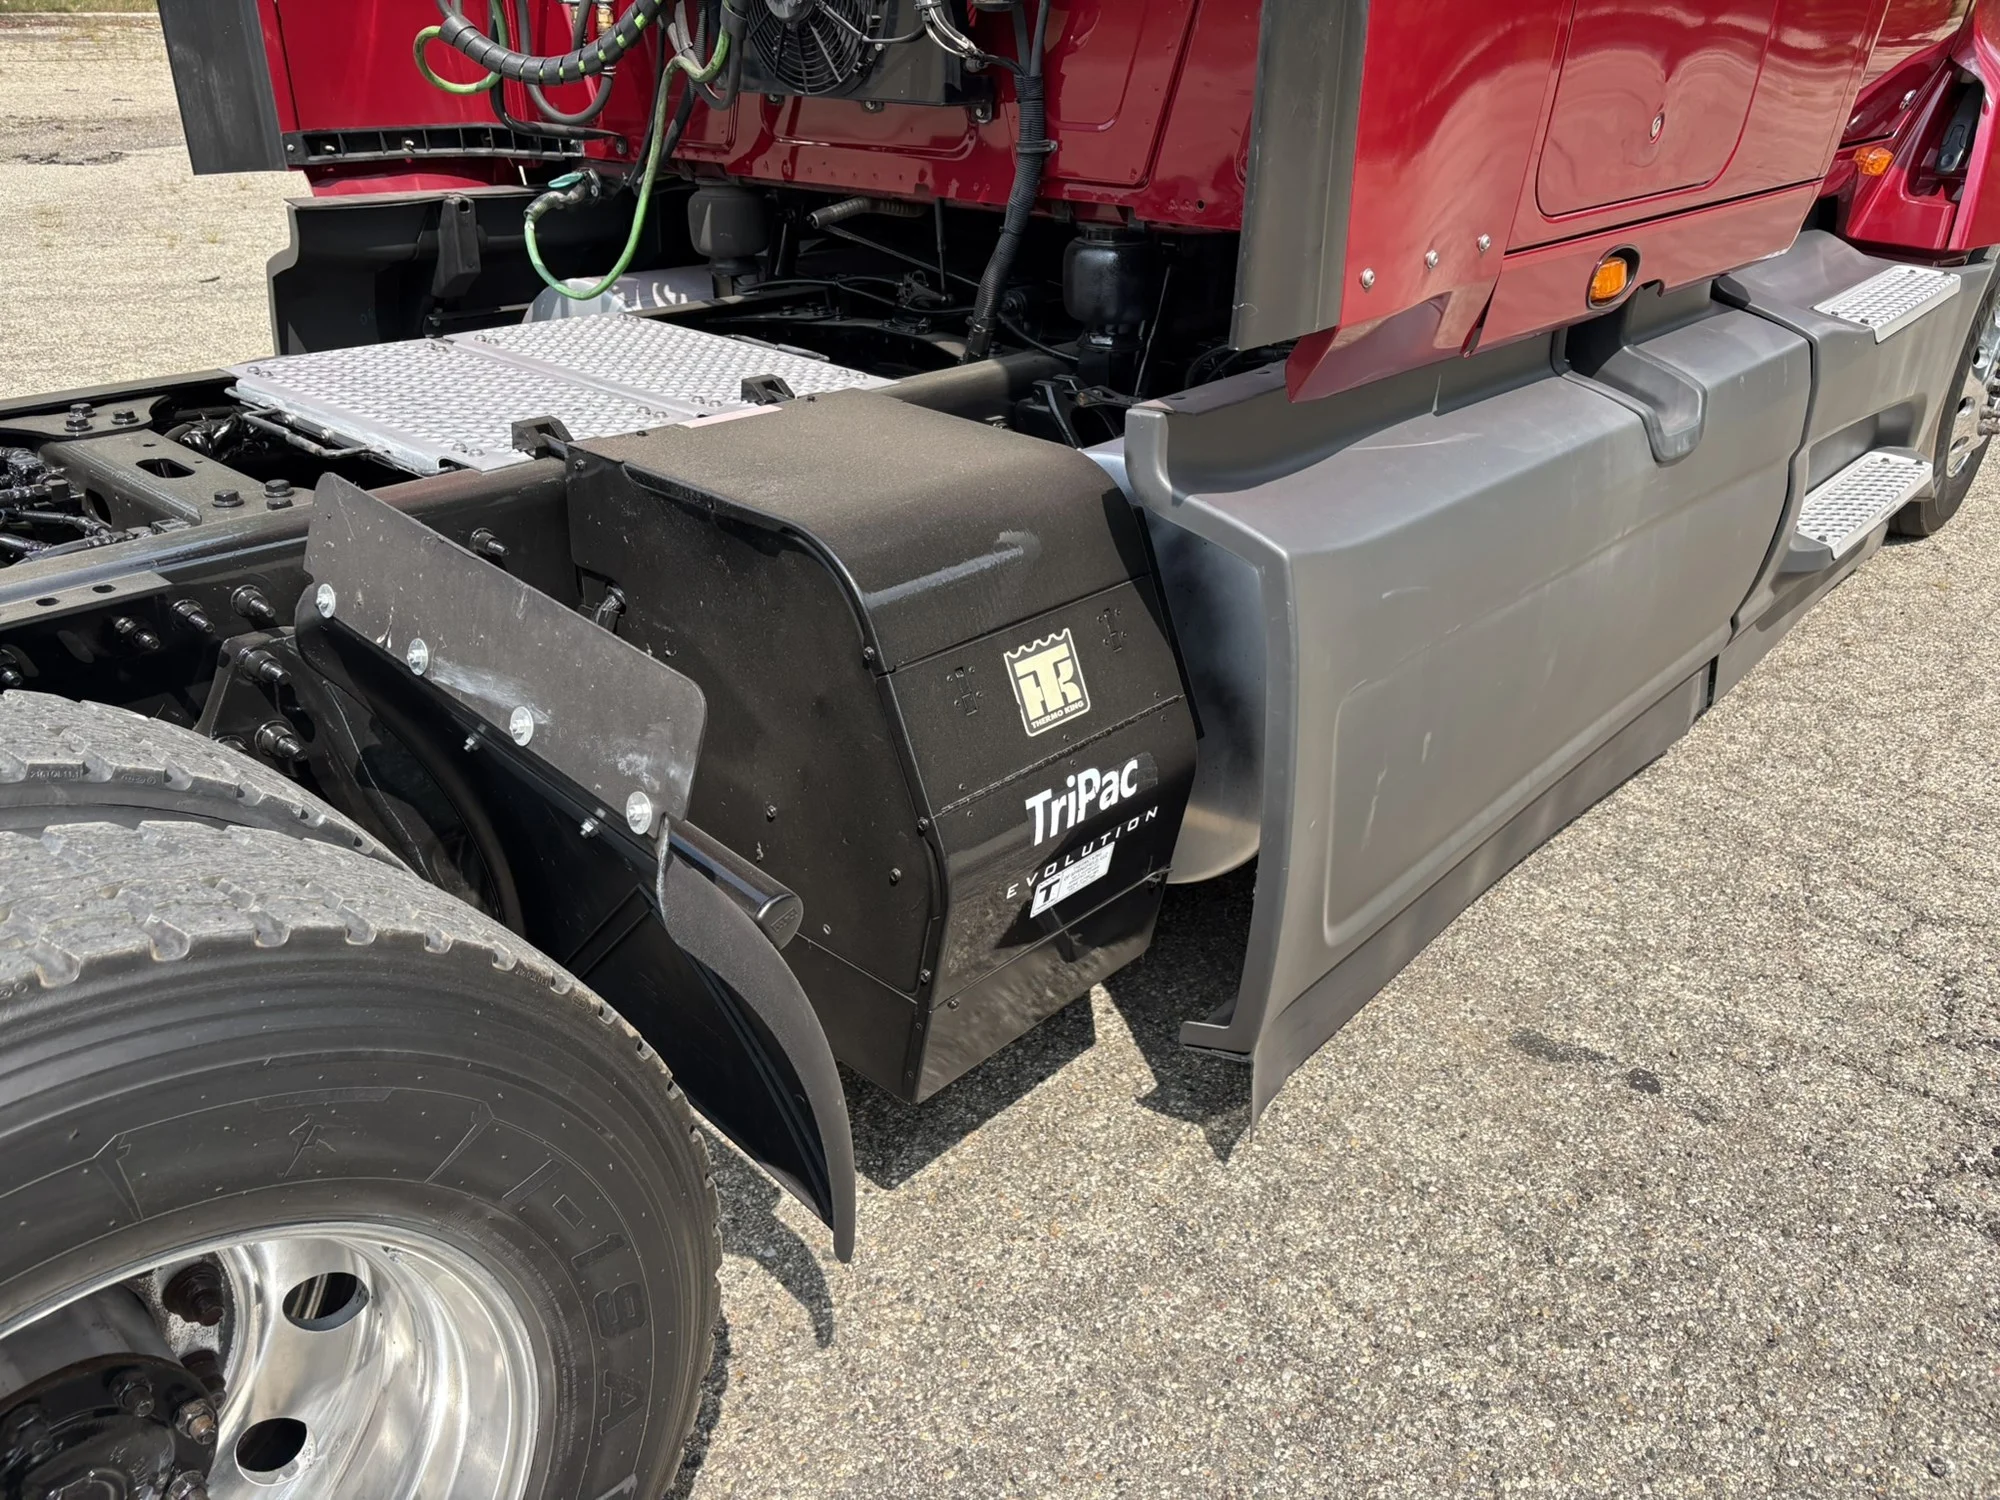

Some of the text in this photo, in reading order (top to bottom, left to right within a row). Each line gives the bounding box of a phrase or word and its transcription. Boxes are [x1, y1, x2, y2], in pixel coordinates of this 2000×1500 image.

[1031, 700, 1084, 728] THERMO KING
[1025, 759, 1138, 846] TriPac
[1006, 806, 1158, 899] EVOLUTION
